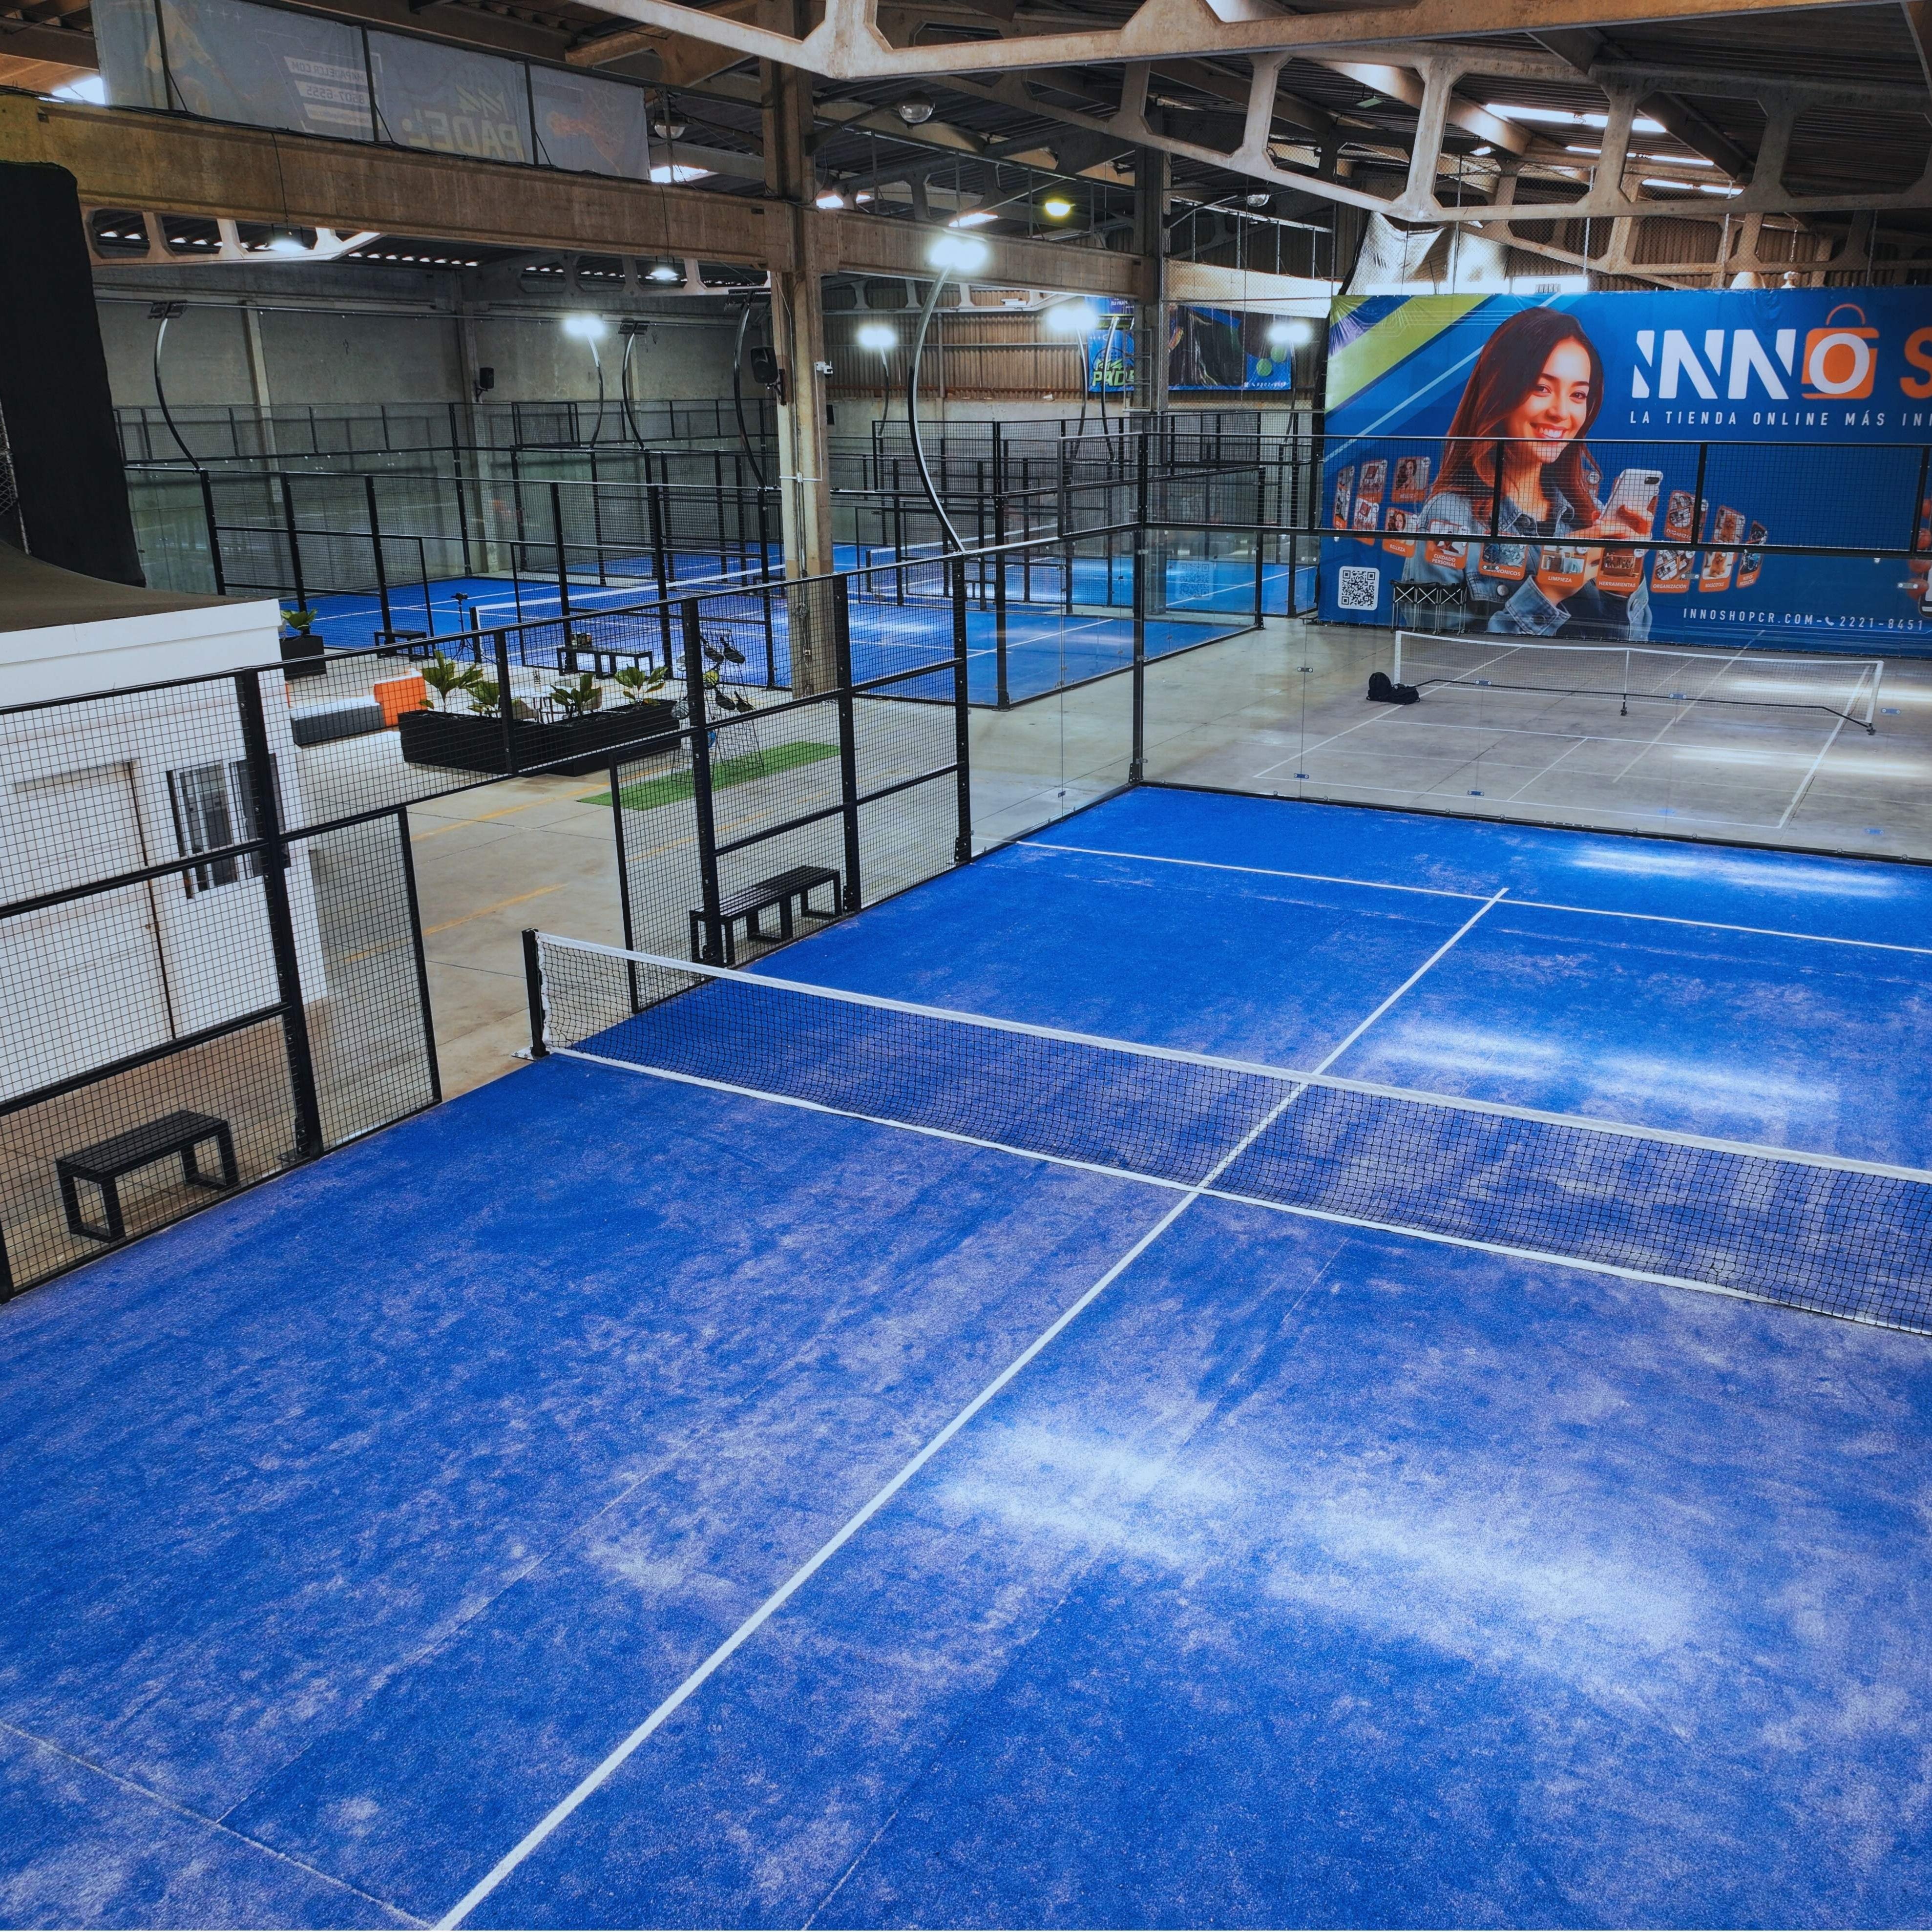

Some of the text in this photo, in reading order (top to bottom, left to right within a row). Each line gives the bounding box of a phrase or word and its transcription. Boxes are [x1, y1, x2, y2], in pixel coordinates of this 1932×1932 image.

[1632, 329, 1870, 399] INNO
[1630, 409, 1932, 426] LA TIENDA ONLINE MÁS IN
[1389, 544, 1406, 552] BELLEZA
[1431, 558, 1456, 567] PERSONAL
[1433, 553, 1456, 562] CUIDADO
[1839, 616, 1923, 630] 2221-8451
